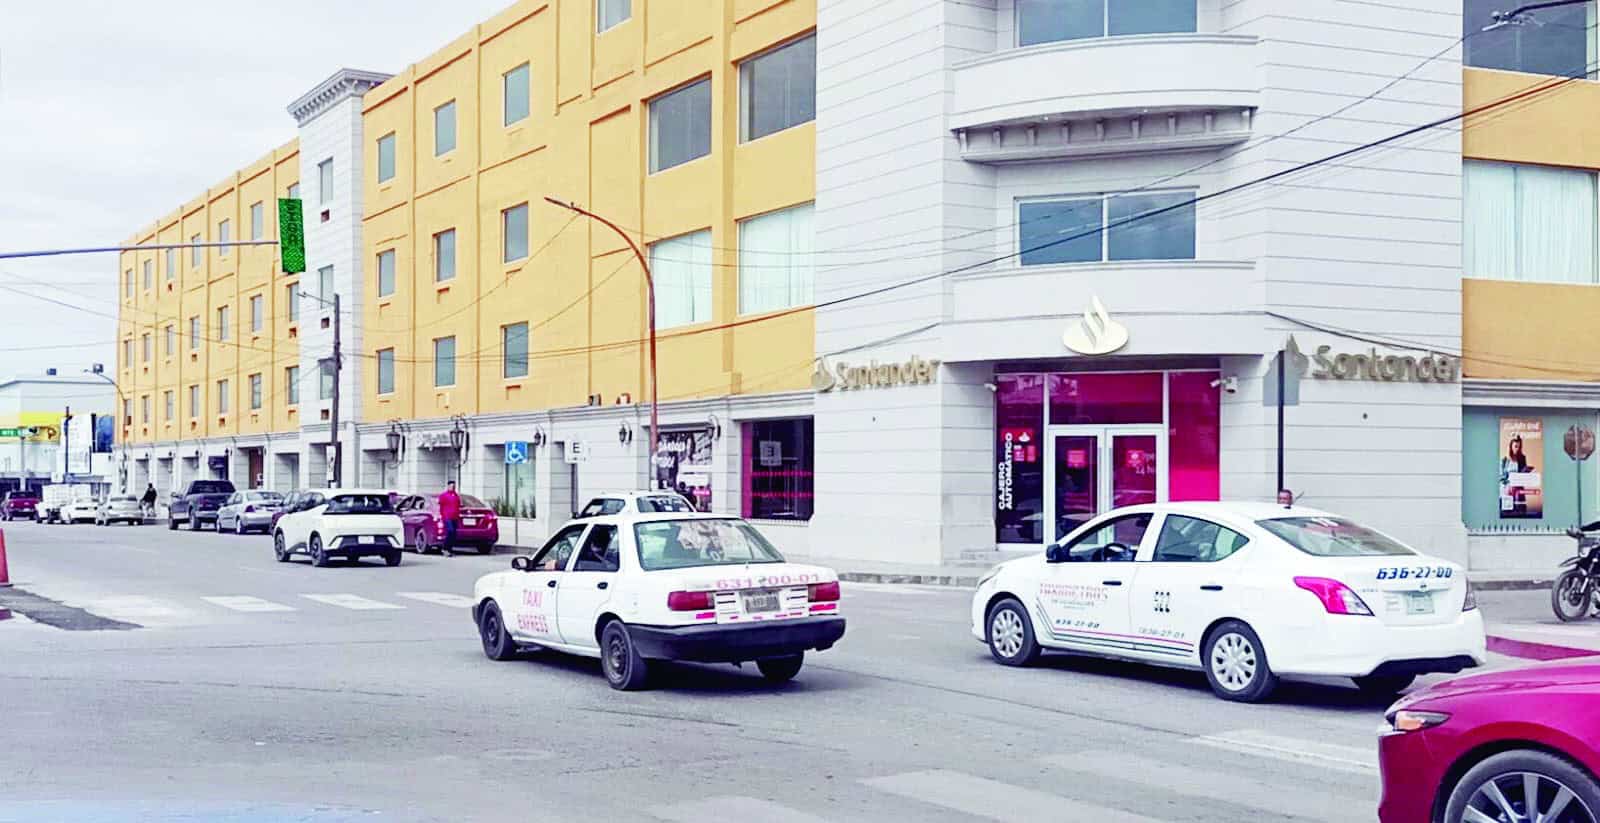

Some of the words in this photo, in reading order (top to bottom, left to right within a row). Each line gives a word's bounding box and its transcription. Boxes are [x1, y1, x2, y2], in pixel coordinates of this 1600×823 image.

[836, 355, 941, 391] Santander
[1312, 344, 1464, 383] Santander
[573, 442, 581, 453] E
[522, 589, 543, 607] TAXI
[517, 614, 549, 633] EXPRESS
